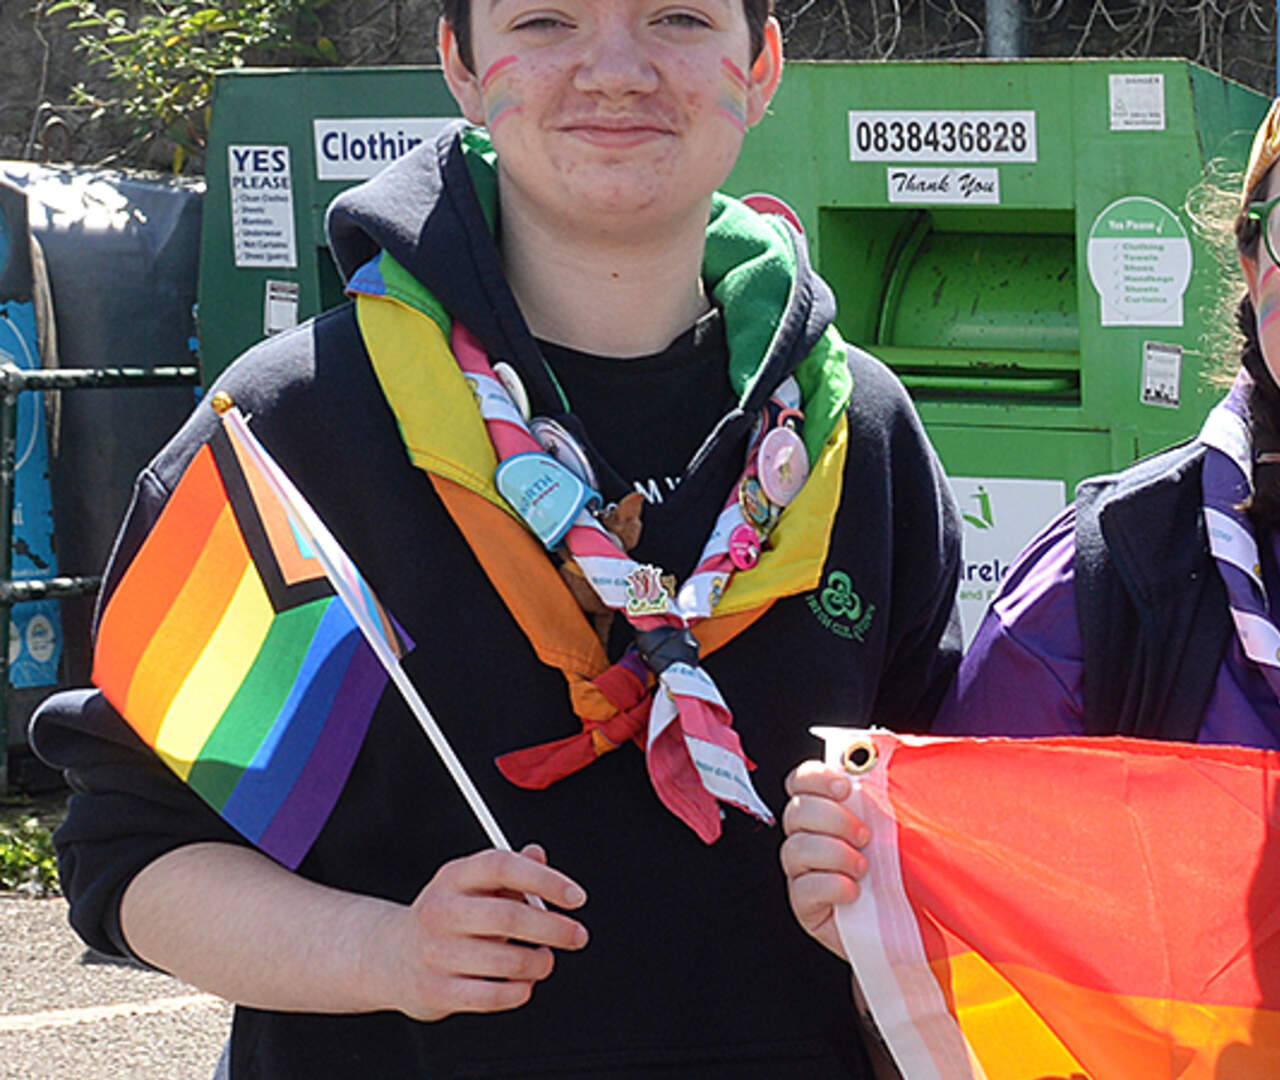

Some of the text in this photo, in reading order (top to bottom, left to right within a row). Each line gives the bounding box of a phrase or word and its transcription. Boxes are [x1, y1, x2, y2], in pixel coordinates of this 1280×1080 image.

[856, 120, 1028, 153] 0838436828
[232, 148, 287, 173] YES
[232, 176, 290, 190] PLEASE
[891, 172, 995, 199] Thank You
[1108, 218, 1156, 231] Yes Please
[1122, 243, 1165, 253] Clothing
[963, 559, 1010, 582] rel
